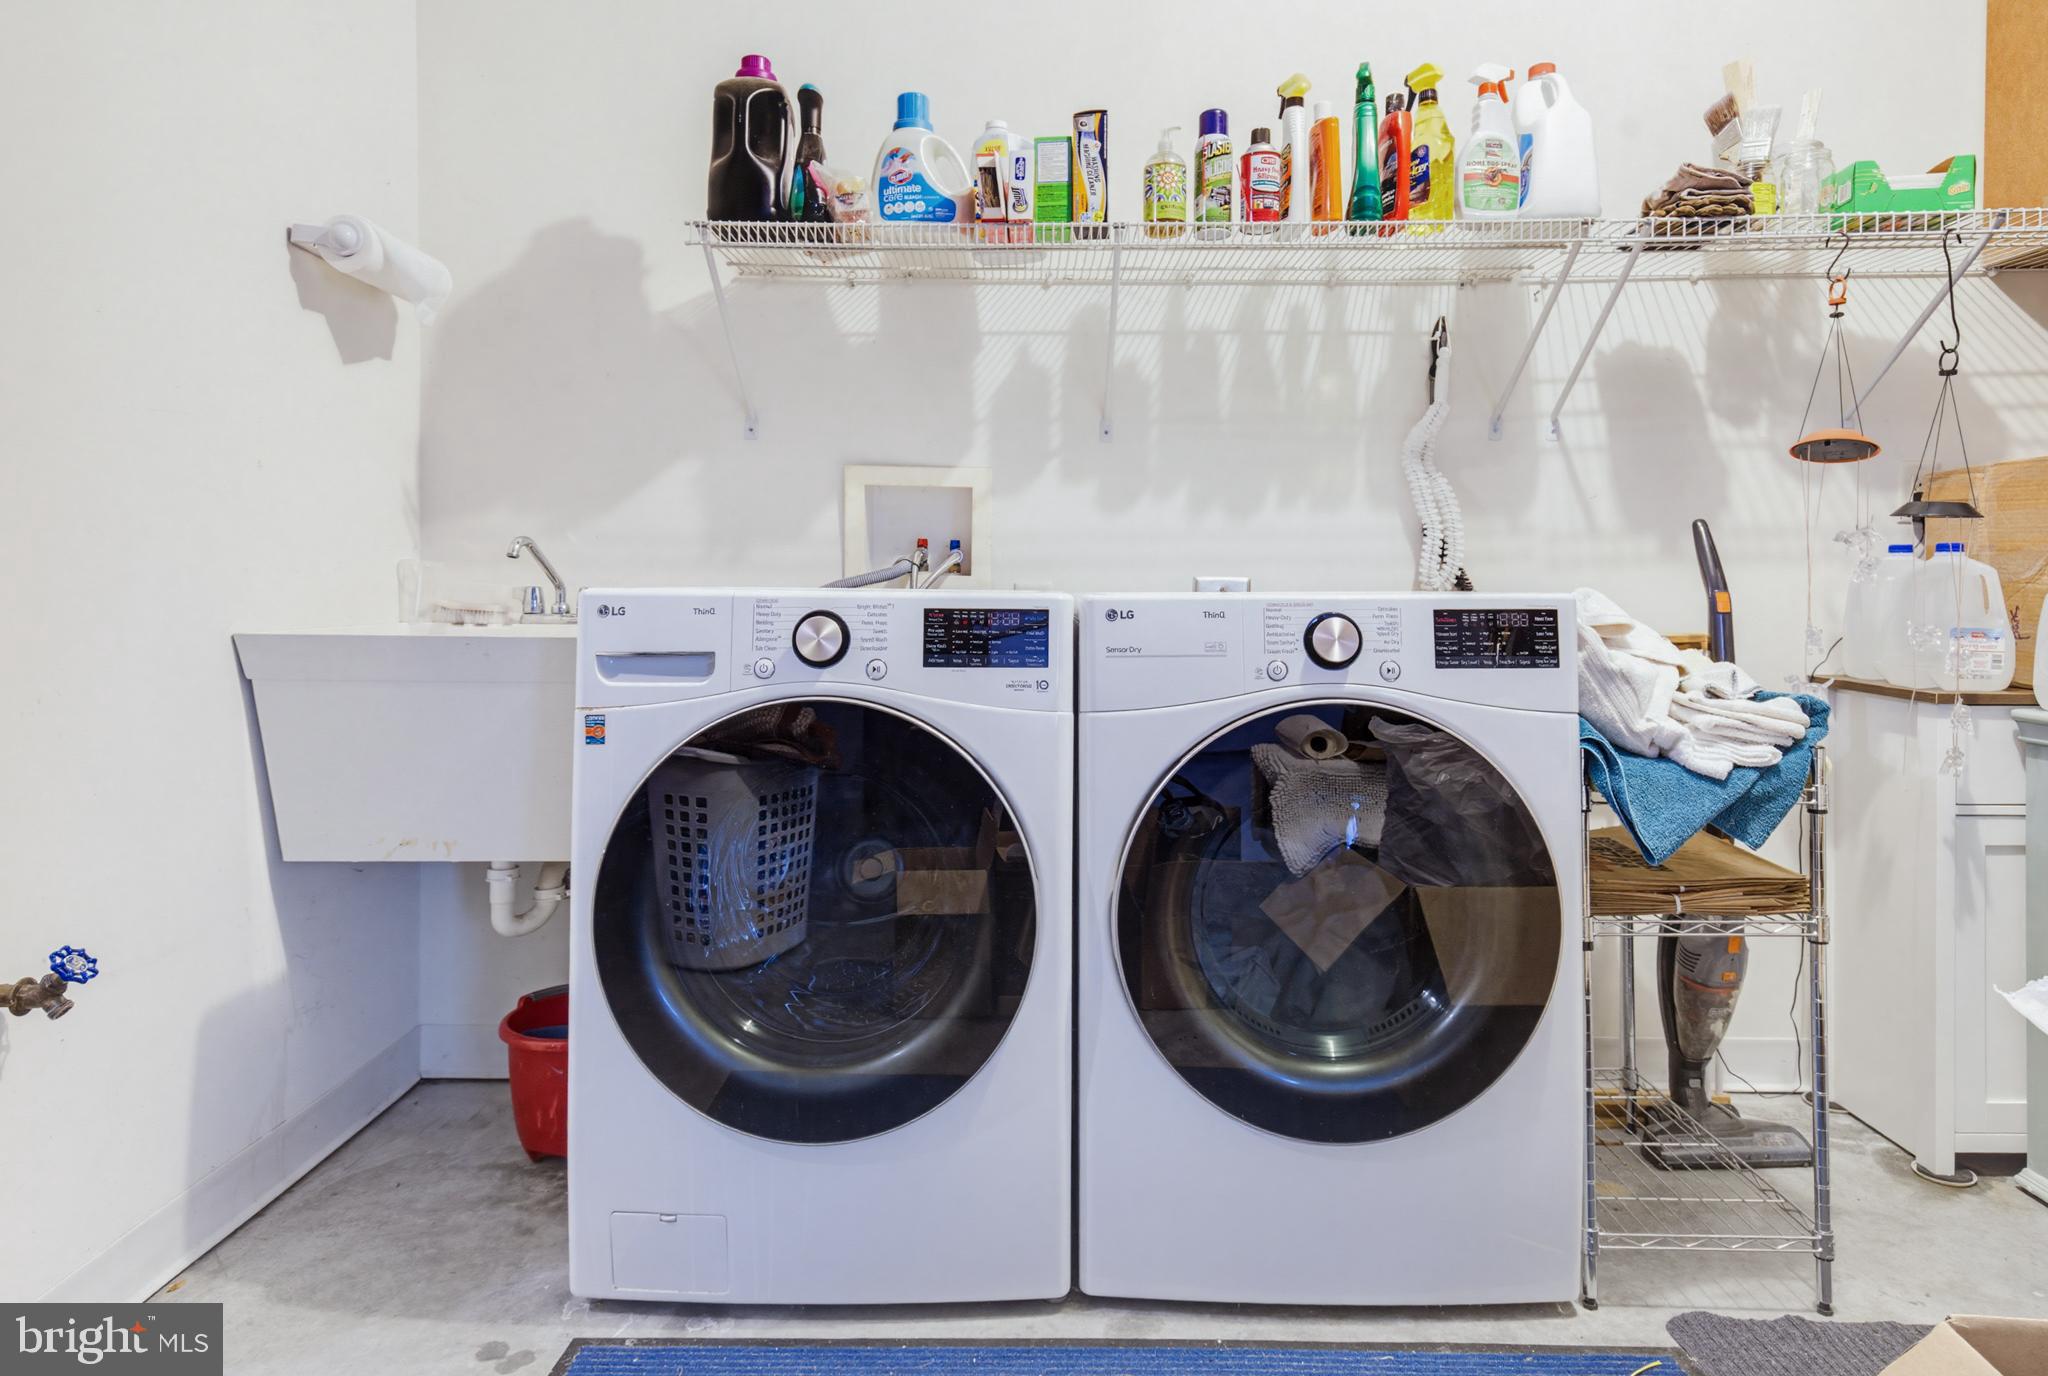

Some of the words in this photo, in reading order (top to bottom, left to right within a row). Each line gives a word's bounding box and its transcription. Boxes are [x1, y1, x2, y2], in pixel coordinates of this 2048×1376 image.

[883, 184, 922, 195] ultimate
[883, 194, 903, 202] care
[611, 606, 626, 616] LG
[1120, 610, 1134, 619] LG
[1203, 610, 1225, 619] ThinQ
[1129, 646, 1142, 654] Dry
